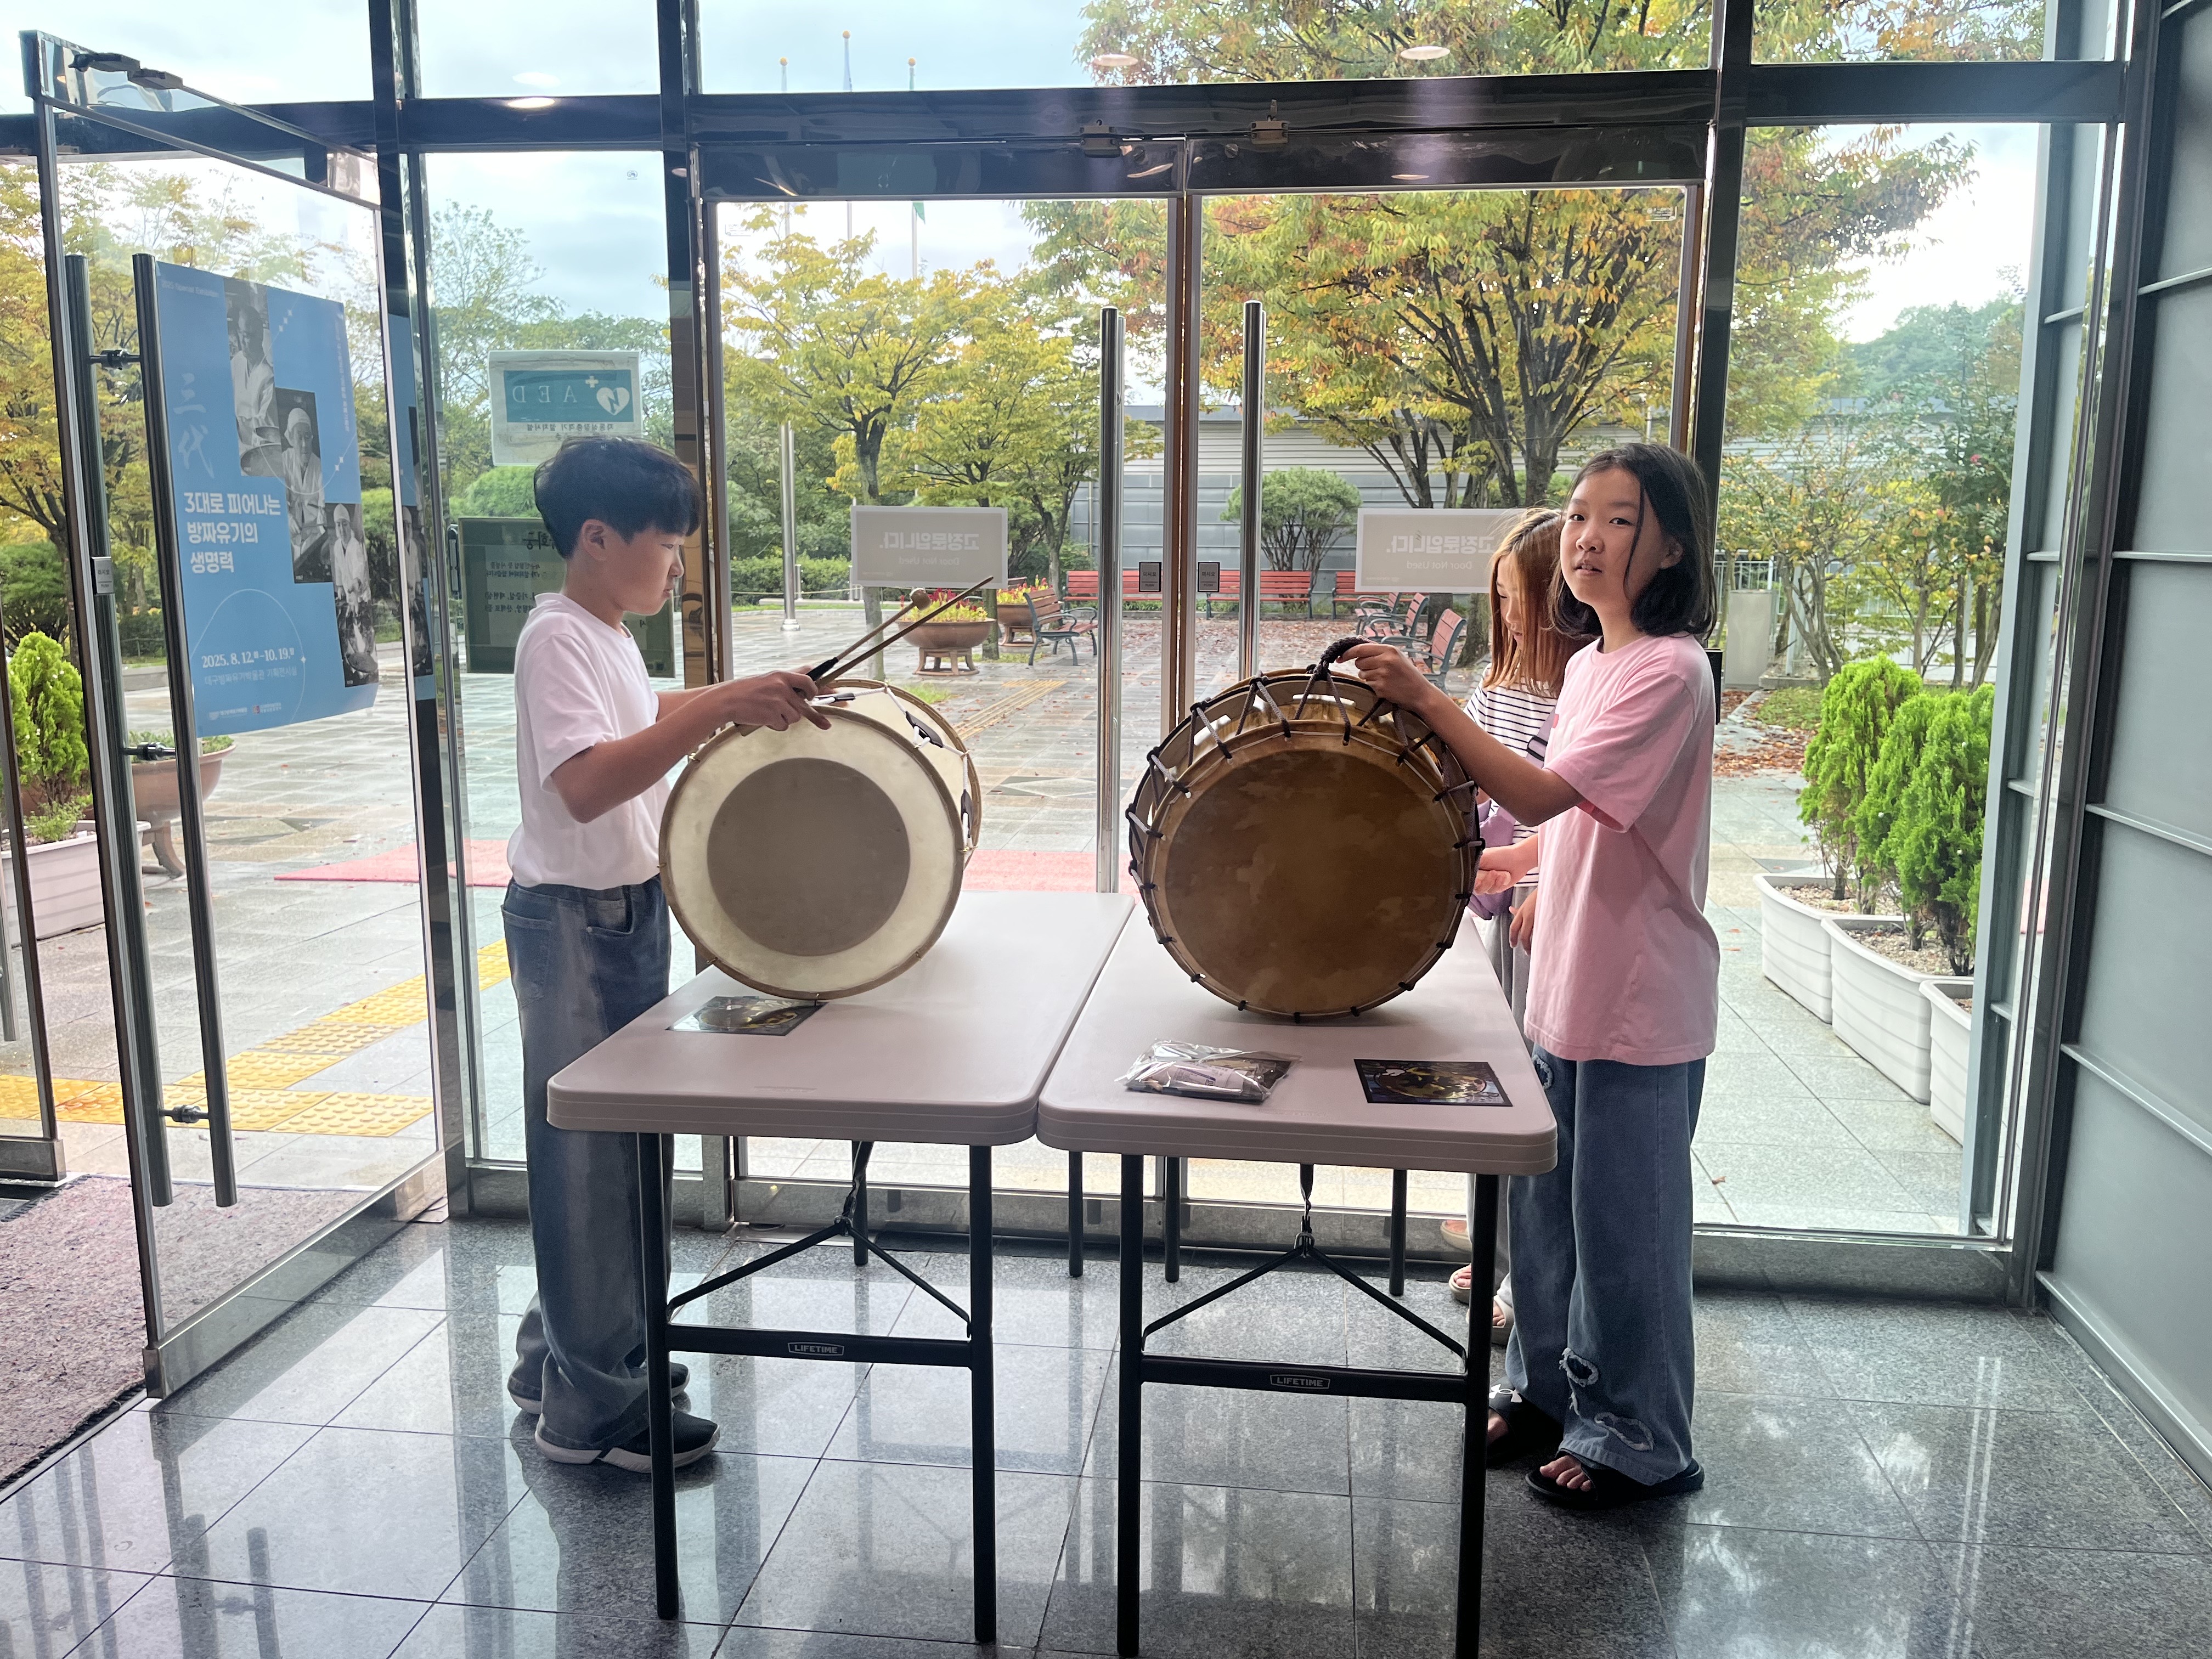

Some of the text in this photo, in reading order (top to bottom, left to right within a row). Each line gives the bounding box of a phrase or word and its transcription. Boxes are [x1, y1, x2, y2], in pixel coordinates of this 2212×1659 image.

[184, 492, 281, 515] 3대로 피어나는
[187, 522, 258, 544] 방짜유기의
[190, 551, 234, 573] 생명력
[201, 654, 229, 668] 2025.
[230, 653, 240, 665] 8.
[794, 1345, 838, 1353] LIFETIME
[1277, 1377, 1323, 1387] LIFETIME
